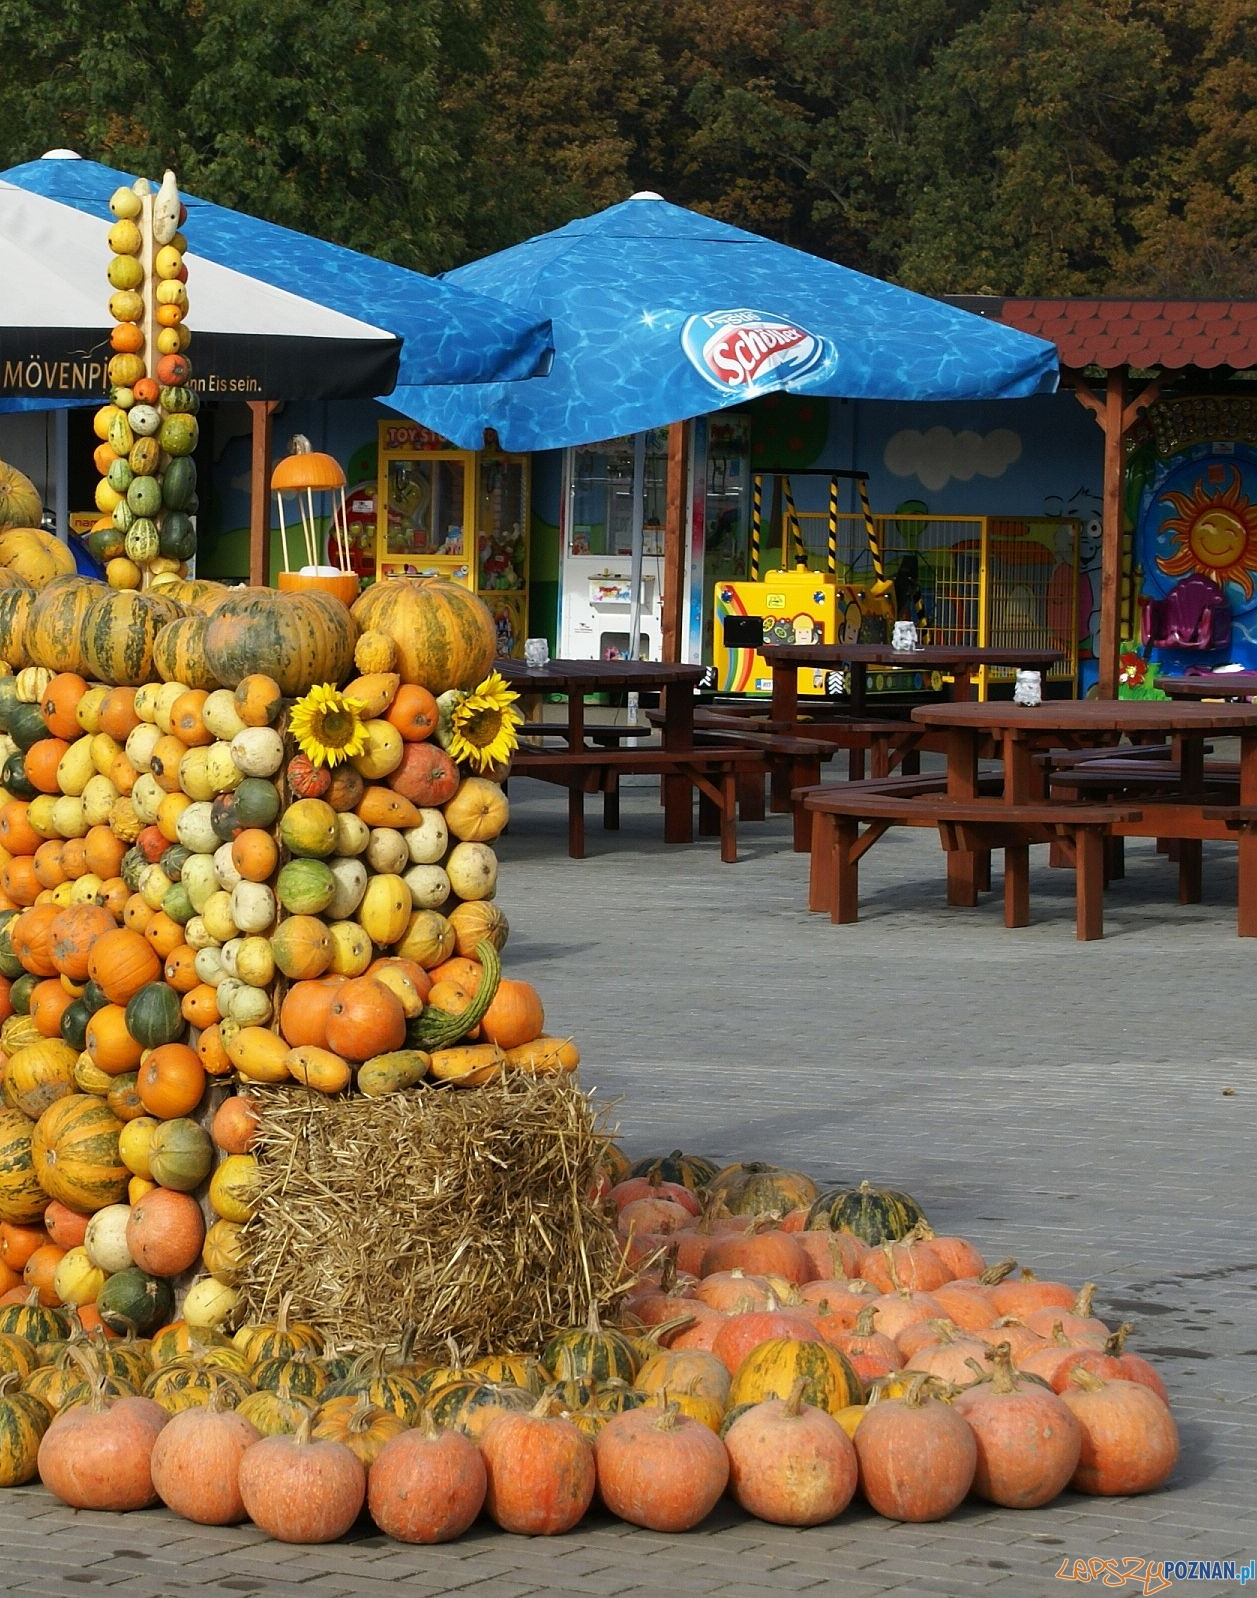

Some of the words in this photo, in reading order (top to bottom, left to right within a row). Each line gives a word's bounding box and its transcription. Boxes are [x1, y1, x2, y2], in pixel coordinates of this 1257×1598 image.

[3, 354, 108, 389] MÖVENPI
[209, 375, 227, 391] Eis
[230, 376, 262, 392] sein.
[713, 328, 802, 386] Schöller
[389, 428, 416, 443] TOY
